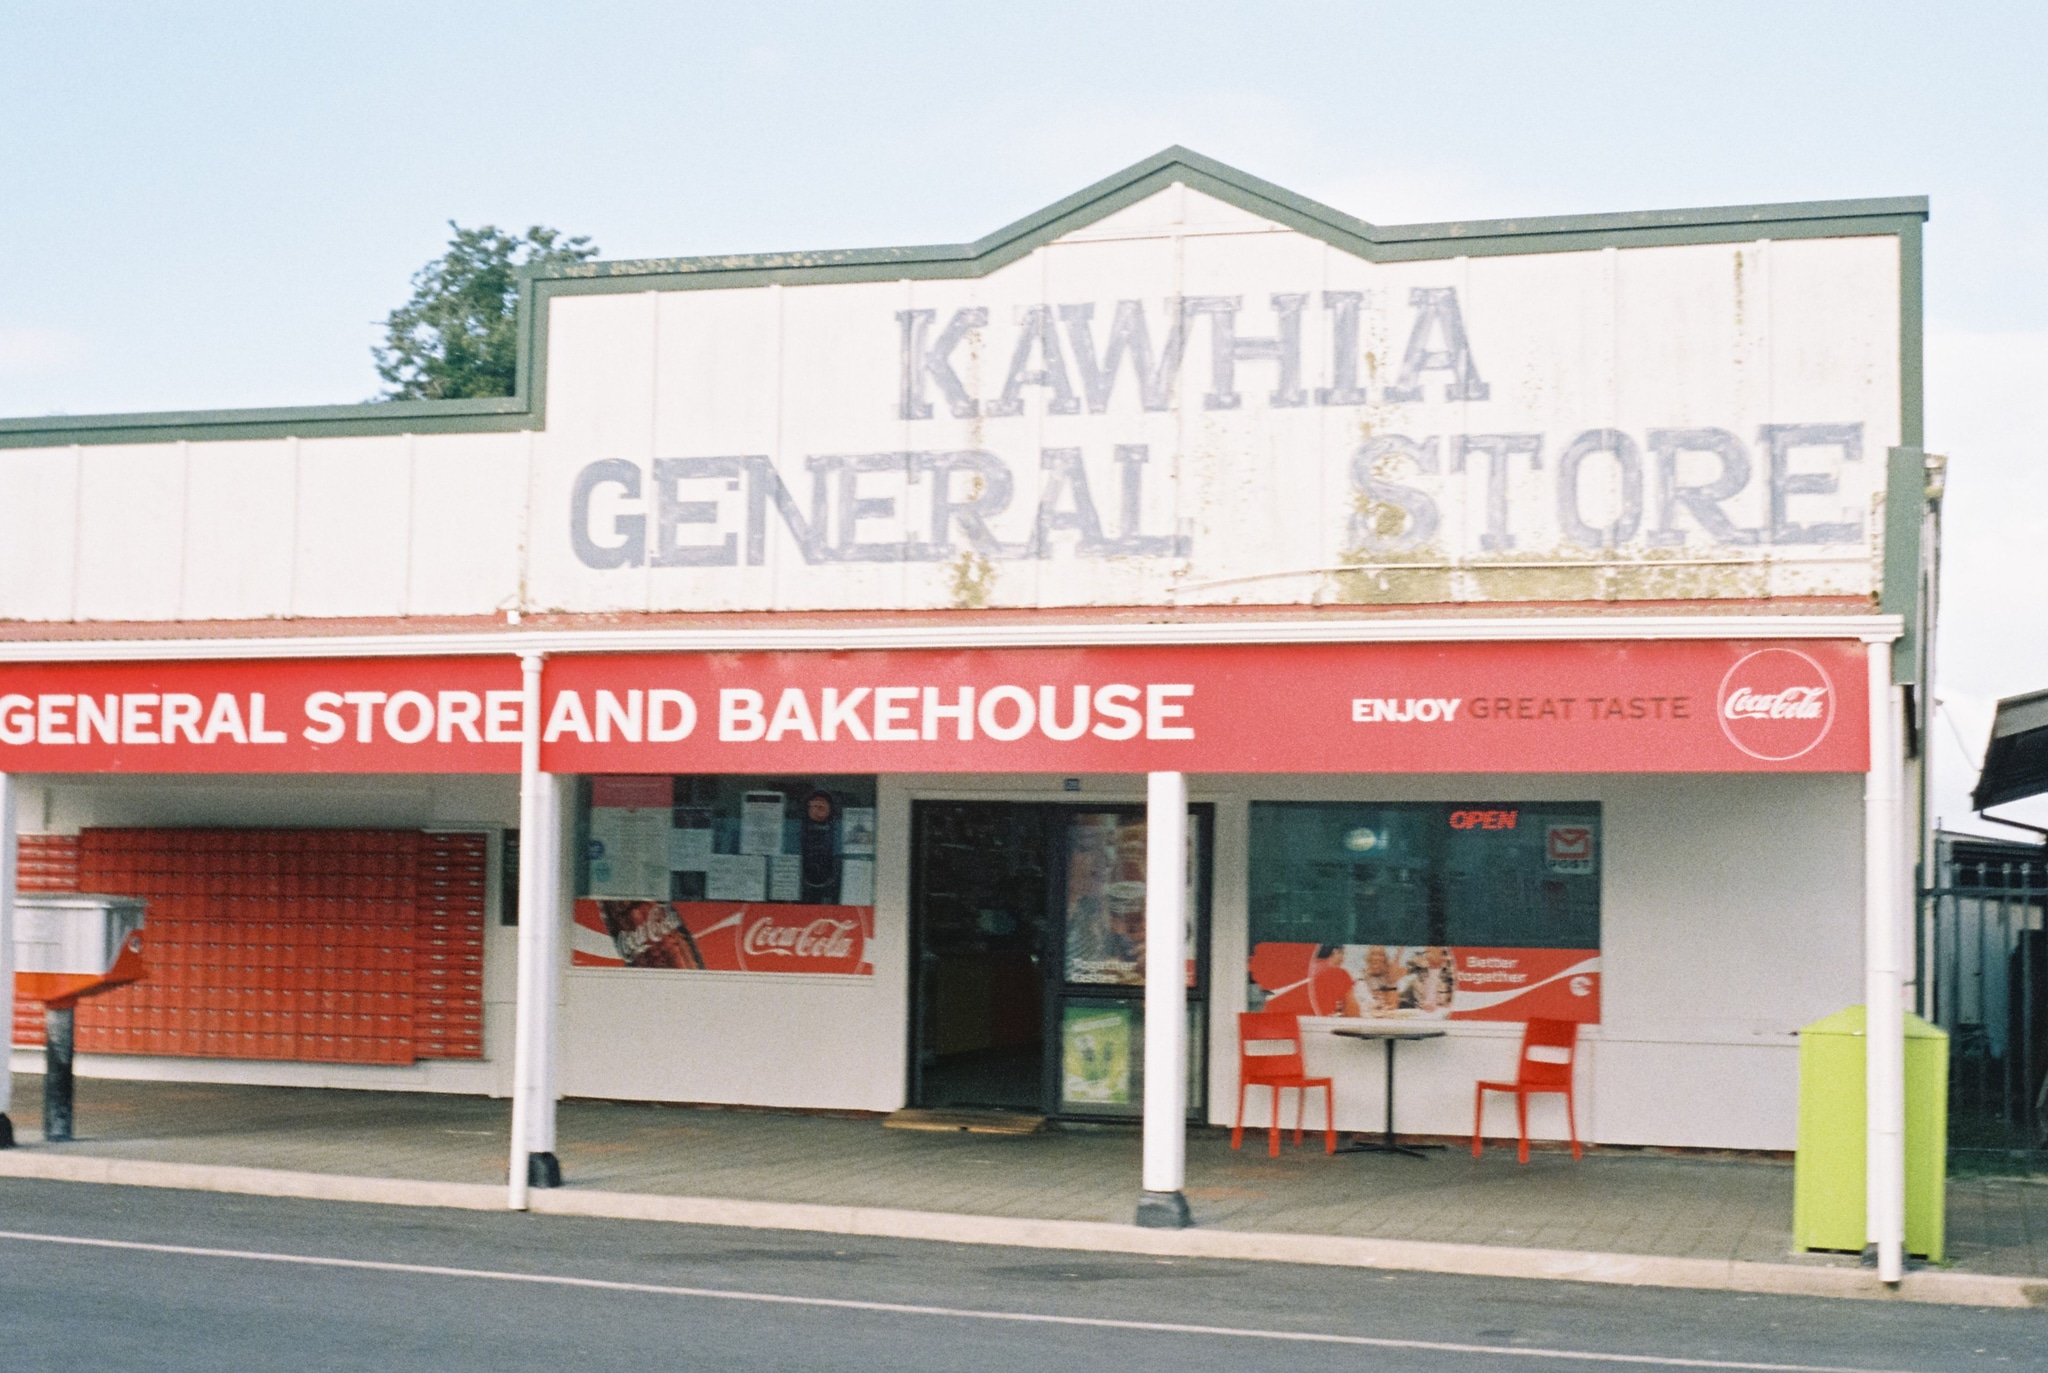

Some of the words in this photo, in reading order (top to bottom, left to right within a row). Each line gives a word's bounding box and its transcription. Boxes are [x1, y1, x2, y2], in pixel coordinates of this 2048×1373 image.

[895, 286, 1490, 420] KAWHIA
[570, 443, 1193, 570] GENERAL
[1350, 420, 1865, 551] STORE
[0, 692, 287, 745] GENERAL
[302, 689, 523, 744] STORE
[542, 688, 698, 743] AND
[718, 683, 1195, 742] BAKEHOUSE
[1351, 697, 1462, 722] ENJOY
[1467, 698, 1576, 720] GREAT
[1587, 696, 1691, 720] TASTE
[1449, 810, 1518, 830] OPEN
[1466, 955, 1519, 969] Better
